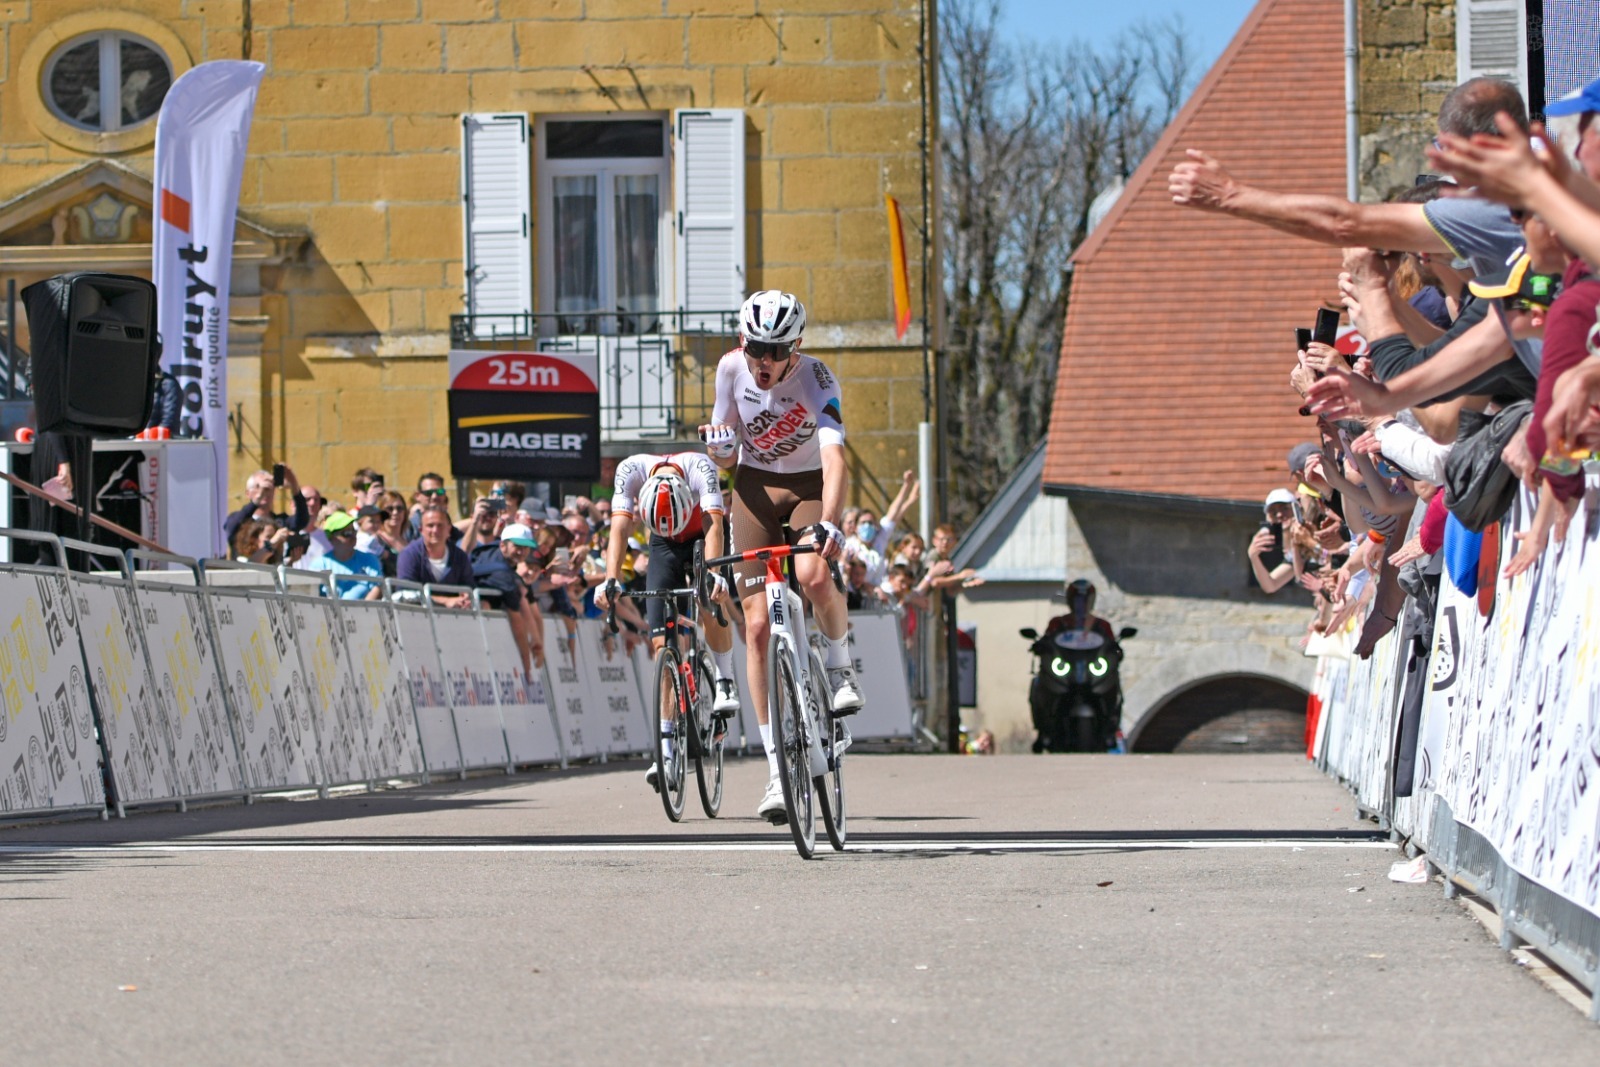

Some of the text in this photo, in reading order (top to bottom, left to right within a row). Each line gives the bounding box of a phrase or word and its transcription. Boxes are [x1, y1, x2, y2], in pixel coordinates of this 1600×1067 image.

[169, 243, 217, 438] colruyt
[488, 360, 560, 386] 25m
[753, 402, 808, 450] CITROËN
[745, 576, 767, 588] BM
[772, 588, 785, 626] BMC
